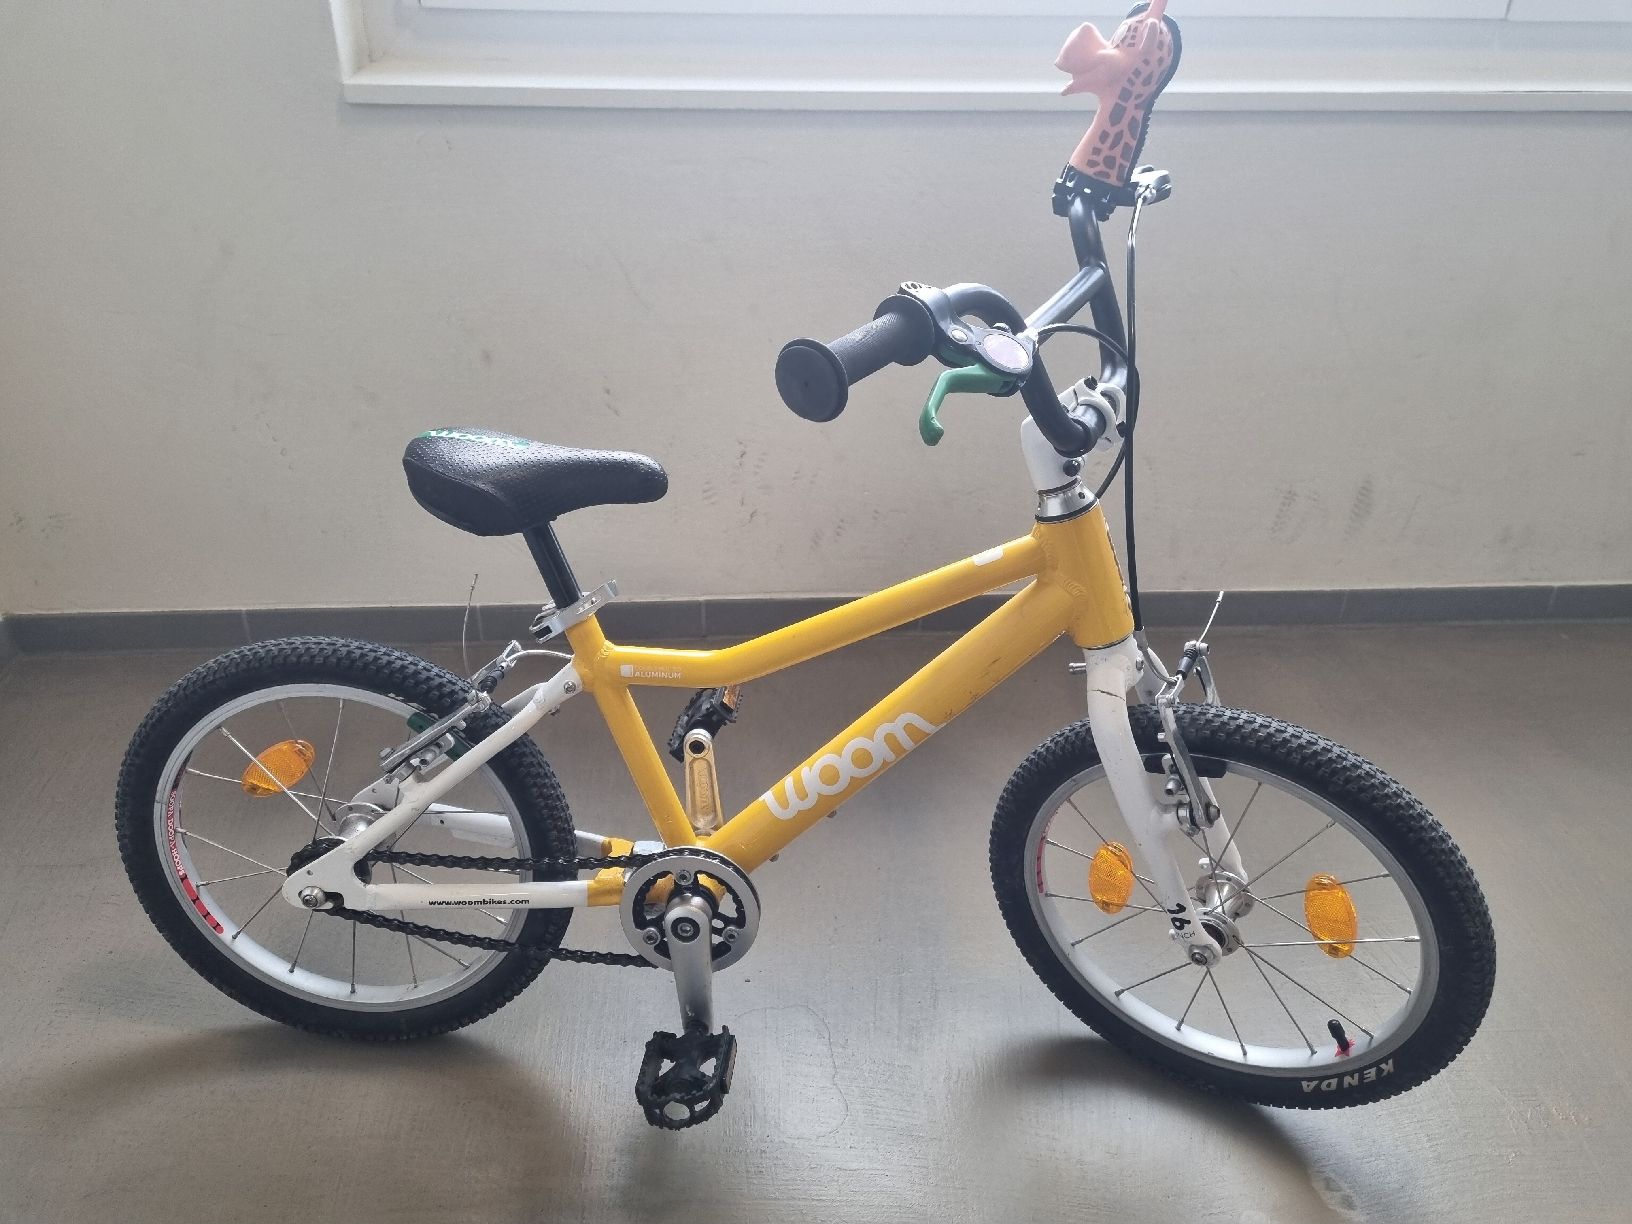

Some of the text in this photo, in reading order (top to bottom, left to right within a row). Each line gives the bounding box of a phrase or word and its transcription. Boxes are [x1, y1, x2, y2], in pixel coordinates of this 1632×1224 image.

[634, 671, 681, 679] ALUMINUM
[758, 712, 937, 820] woom
[171, 848, 186, 876] HOOPS
[428, 898, 530, 906] www.woombikes.com
[1166, 902, 1192, 931] 16
[1301, 1058, 1395, 1093] KENDA
